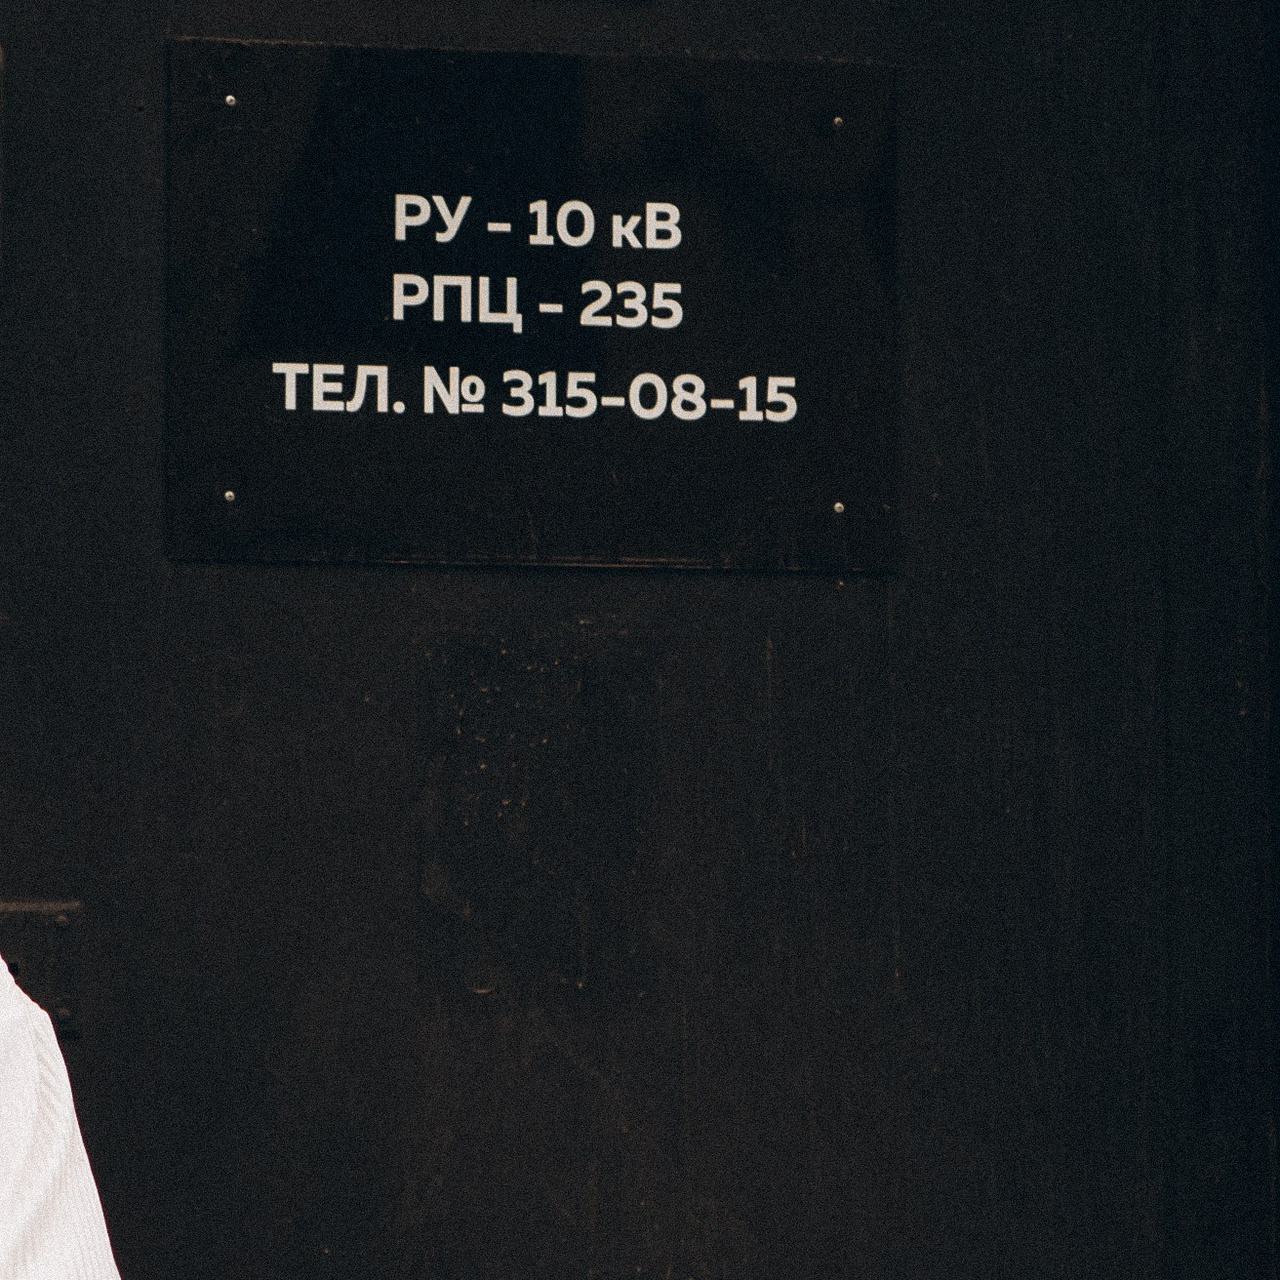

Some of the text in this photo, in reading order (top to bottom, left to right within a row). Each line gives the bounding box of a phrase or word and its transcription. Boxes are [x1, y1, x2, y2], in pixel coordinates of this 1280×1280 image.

[394, 193, 473, 243] РУ
[528, 199, 596, 248] 10
[611, 201, 682, 250] кВ
[392, 273, 523, 334] РПЦ
[579, 279, 684, 329] 235
[271, 362, 798, 423] ТЕЛ. № 315-08-15
